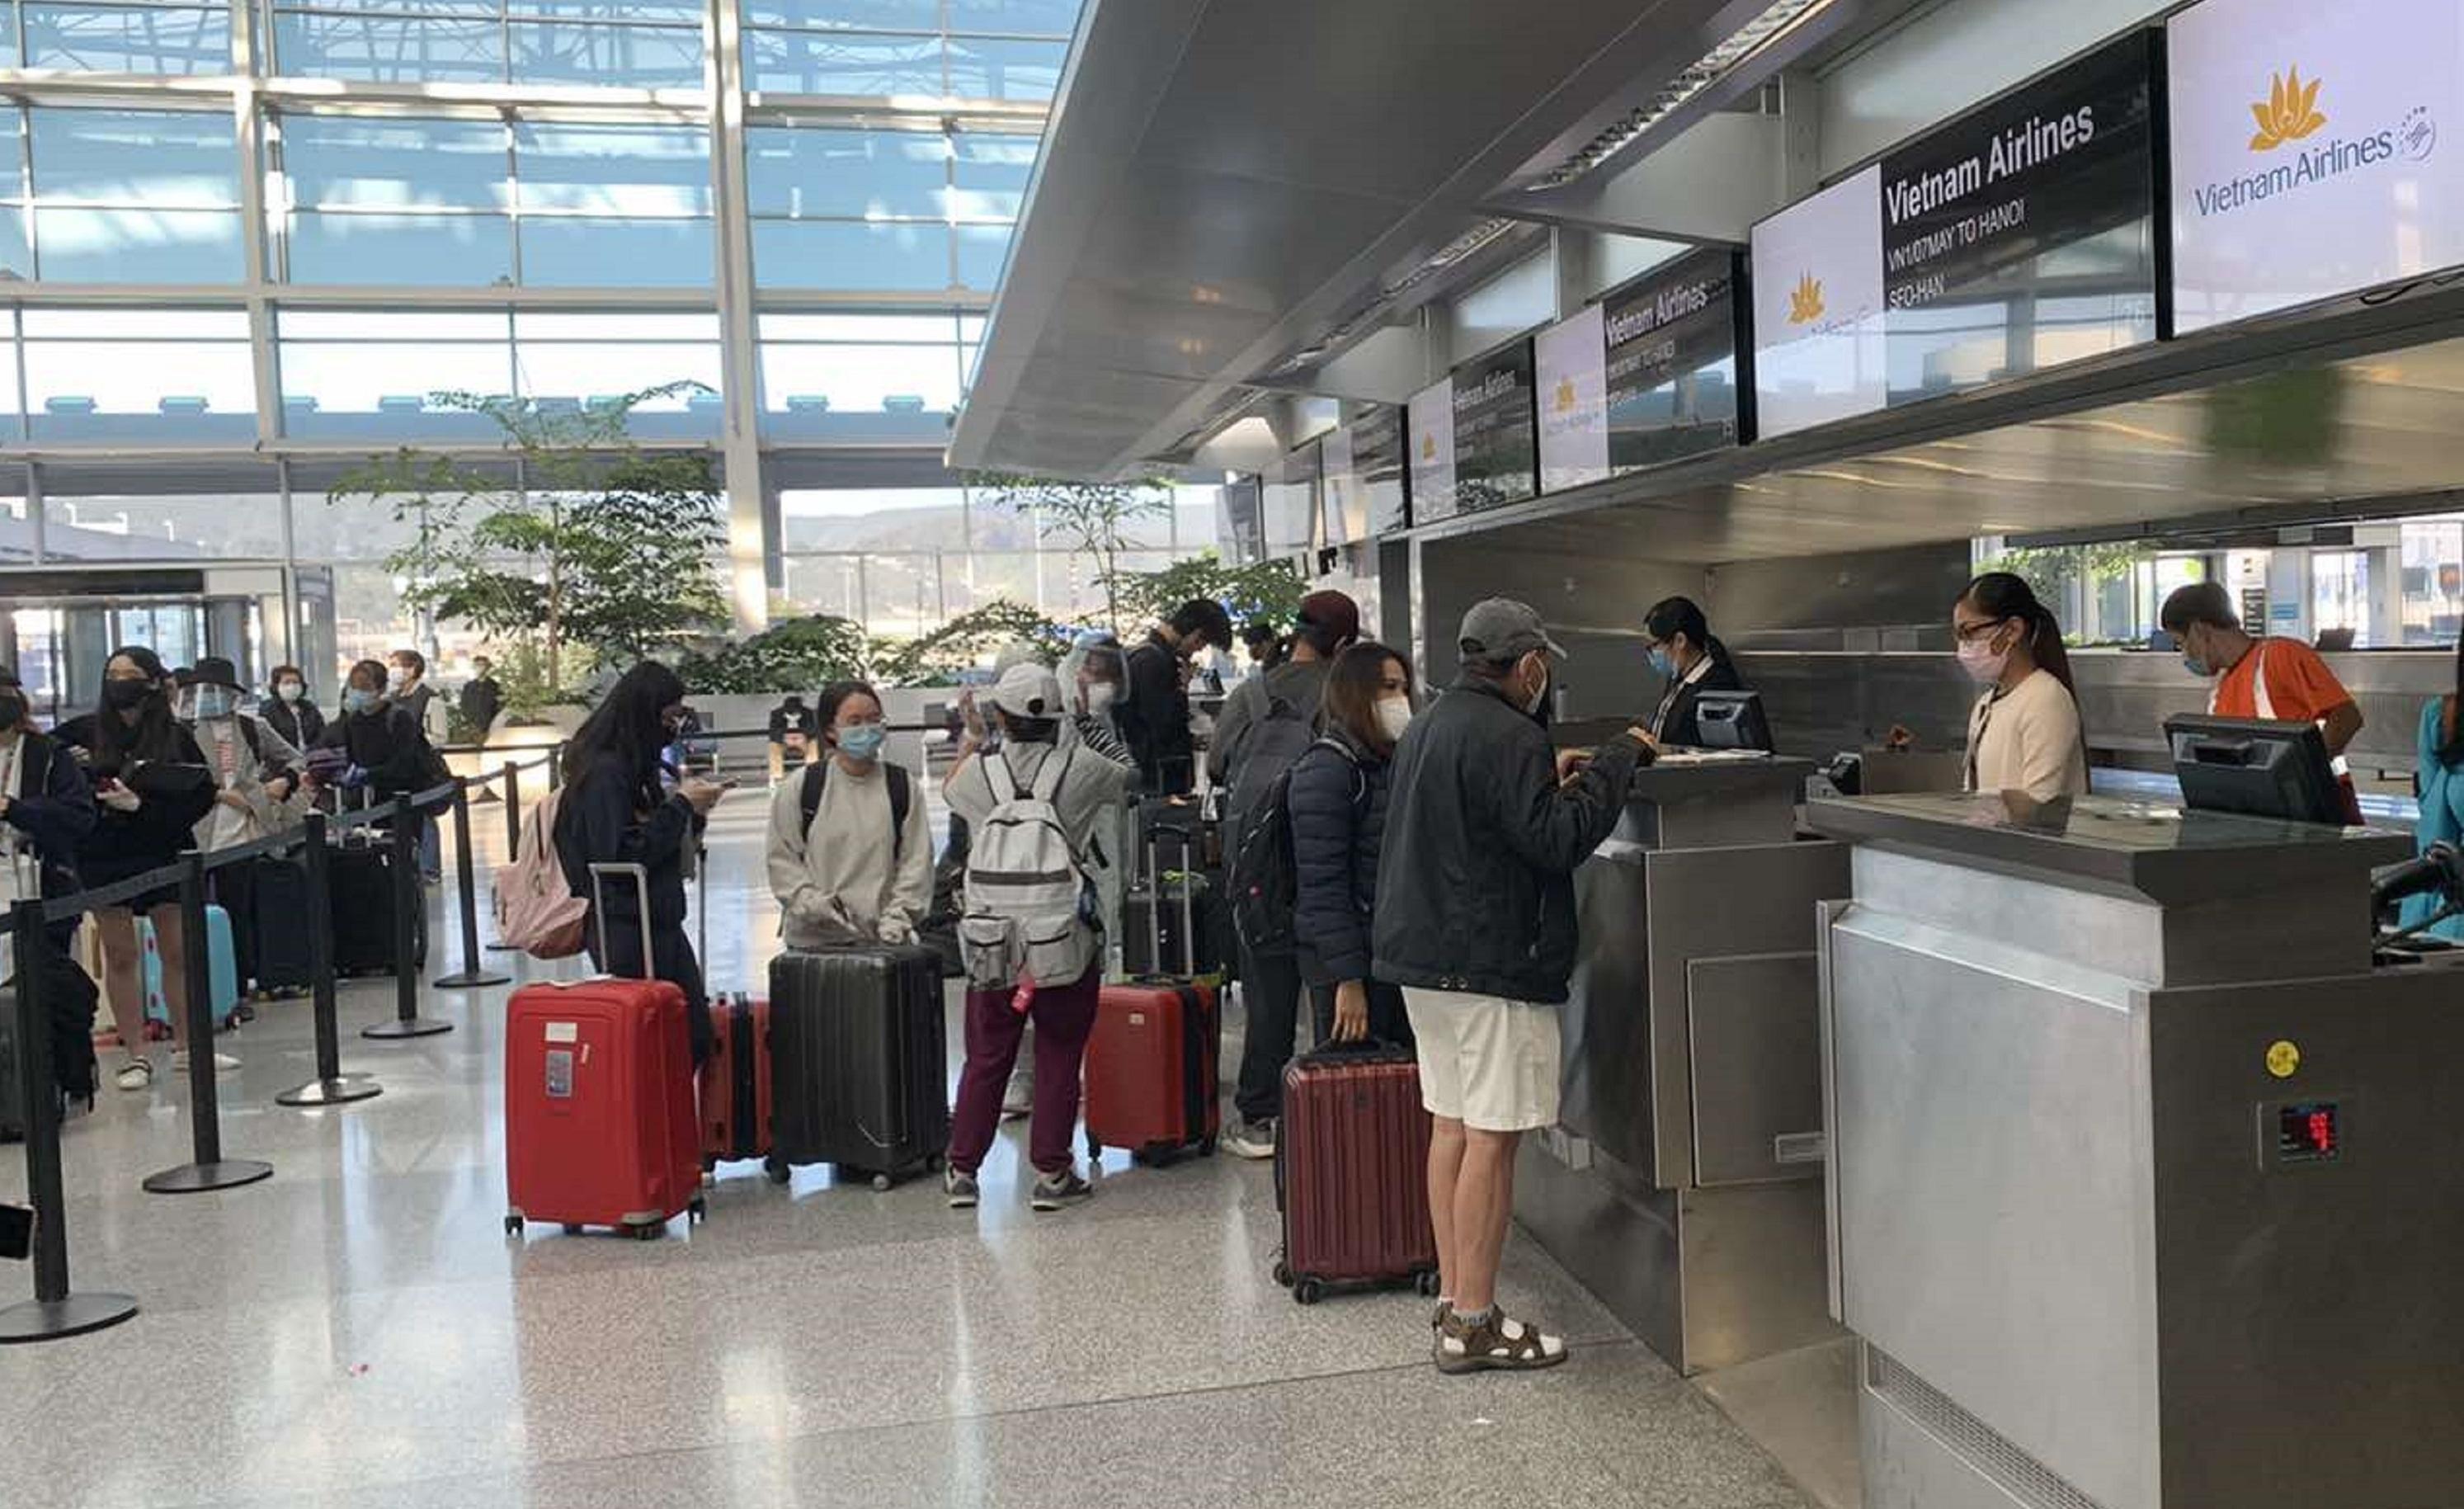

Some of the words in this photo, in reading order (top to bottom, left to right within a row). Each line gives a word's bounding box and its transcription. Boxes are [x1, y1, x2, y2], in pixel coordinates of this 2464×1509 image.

[1887, 156, 1981, 225] Vietnam
[1987, 106, 2094, 184] Airlines
[2194, 164, 2292, 216] Vietnam
[2293, 130, 2393, 187] Airlines
[1957, 218, 1976, 245] TO
[1979, 198, 2026, 238] HANOI
